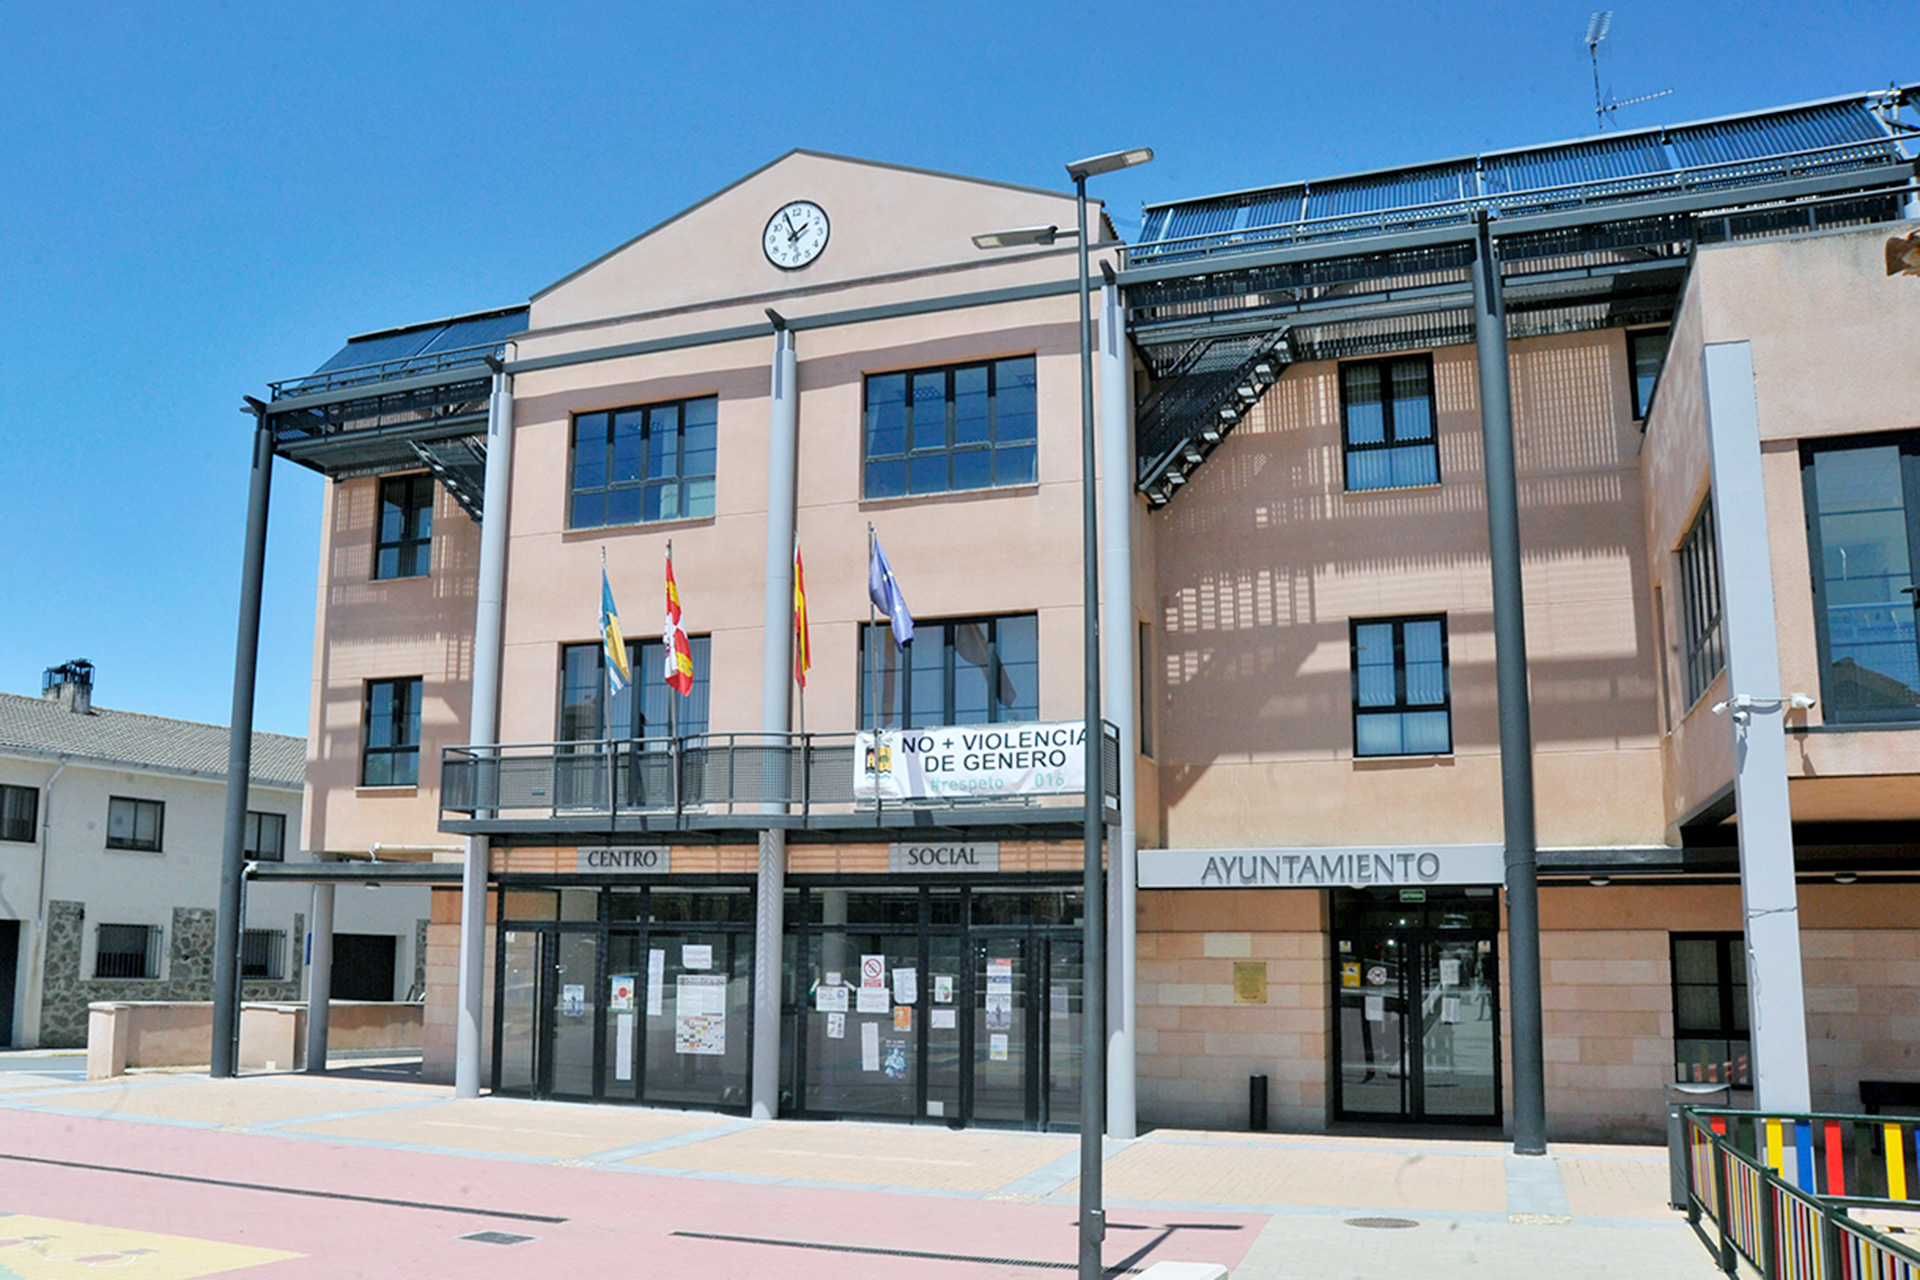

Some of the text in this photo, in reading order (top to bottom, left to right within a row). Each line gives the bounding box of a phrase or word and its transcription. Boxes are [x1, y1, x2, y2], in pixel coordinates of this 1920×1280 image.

[793, 208, 802, 216] 12
[807, 209, 811, 217] 1
[814, 216, 820, 225] 2
[774, 223, 782, 232] 10
[817, 227, 823, 236] 3
[769, 235, 776, 243] 9
[773, 246, 779, 254] 8
[804, 249, 811, 258] 5
[781, 253, 787, 261] 7
[792, 254, 799, 263] 6
[902, 736, 934, 753] NO
[942, 739, 954, 750] +
[925, 750, 1066, 772] DE GENERO
[930, 773, 1065, 793] #respeto 016
[588, 850, 658, 867] CENTRO
[908, 847, 980, 866] SOCIAL
[1201, 852, 1440, 883] AYUNTAMIENTO
